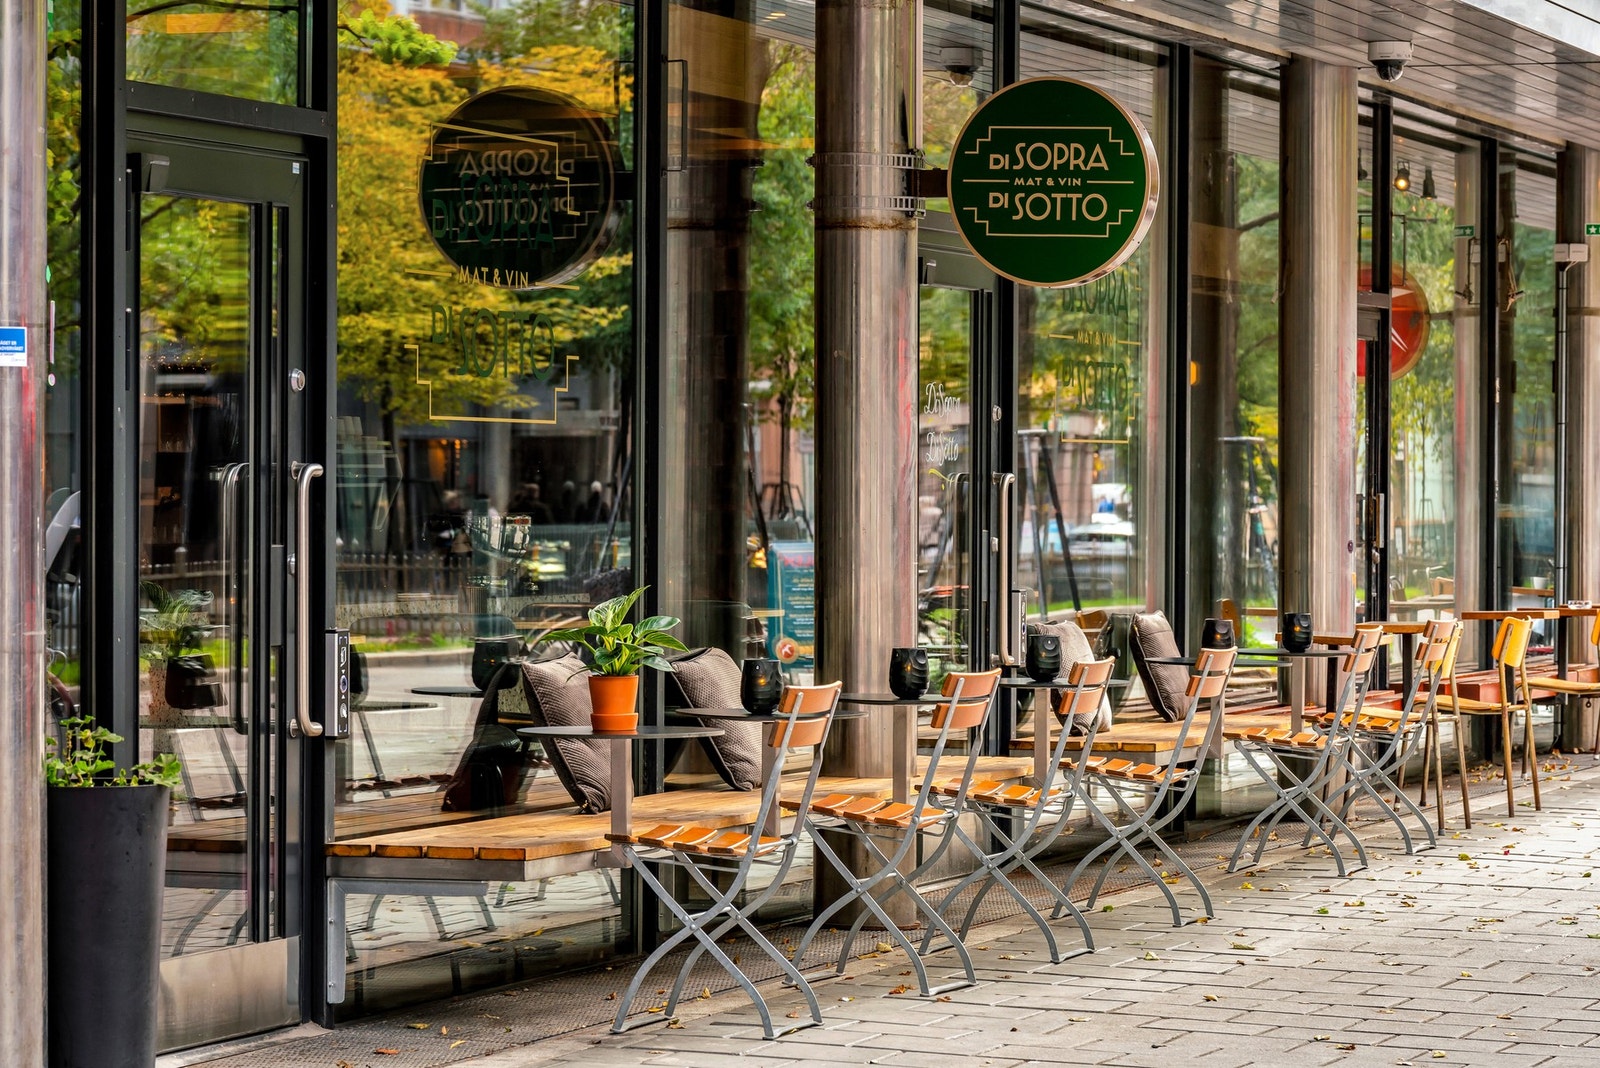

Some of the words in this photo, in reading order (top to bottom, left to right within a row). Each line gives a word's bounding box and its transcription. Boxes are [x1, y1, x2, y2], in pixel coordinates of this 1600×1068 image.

[989, 154, 1009, 170] DI
[1013, 142, 1109, 171] SOPRA
[1014, 177, 1042, 186] MAT
[1046, 177, 1055, 186] &
[1058, 177, 1081, 186] VIN
[989, 192, 1009, 208] DI
[1012, 193, 1108, 221] SOTTO
[459, 265, 489, 285] MAT
[493, 268, 501, 287] &
[505, 269, 529, 289] VIN
[431, 304, 453, 344] DI
[457, 307, 555, 381] SOTTO
[1077, 330, 1093, 344] MAT
